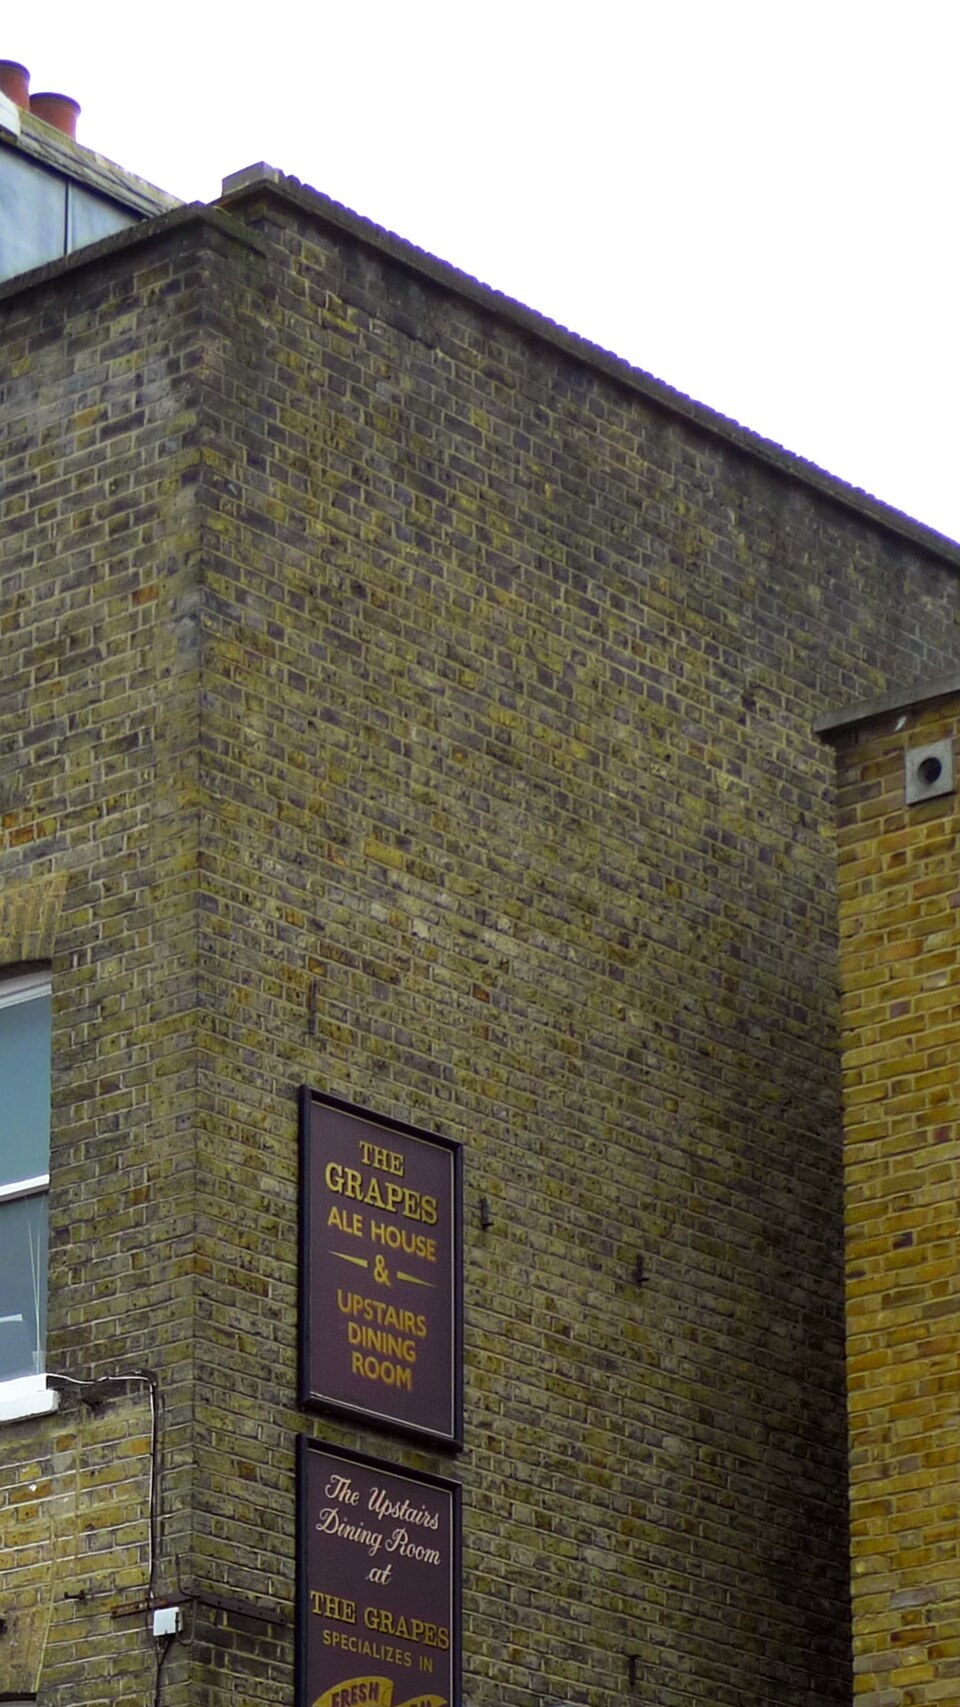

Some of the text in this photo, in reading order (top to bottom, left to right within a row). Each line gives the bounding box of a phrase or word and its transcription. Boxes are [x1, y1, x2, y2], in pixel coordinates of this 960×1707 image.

[359, 1140, 405, 1177] THE
[325, 1162, 438, 1226] GRAPES
[328, 1206, 437, 1262] ALE HOUSE
[373, 1254, 391, 1286] &
[337, 1289, 427, 1338] UPSTAIRS
[348, 1322, 417, 1363] DINING
[352, 1351, 413, 1391] ROOM
[324, 1473, 441, 1531] The Upstairs
[315, 1506, 441, 1566] Dining Room
[365, 1563, 393, 1586] at
[310, 1589, 451, 1651] THE GRAPES
[322, 1628, 434, 1674] SPECIALIZES IN
